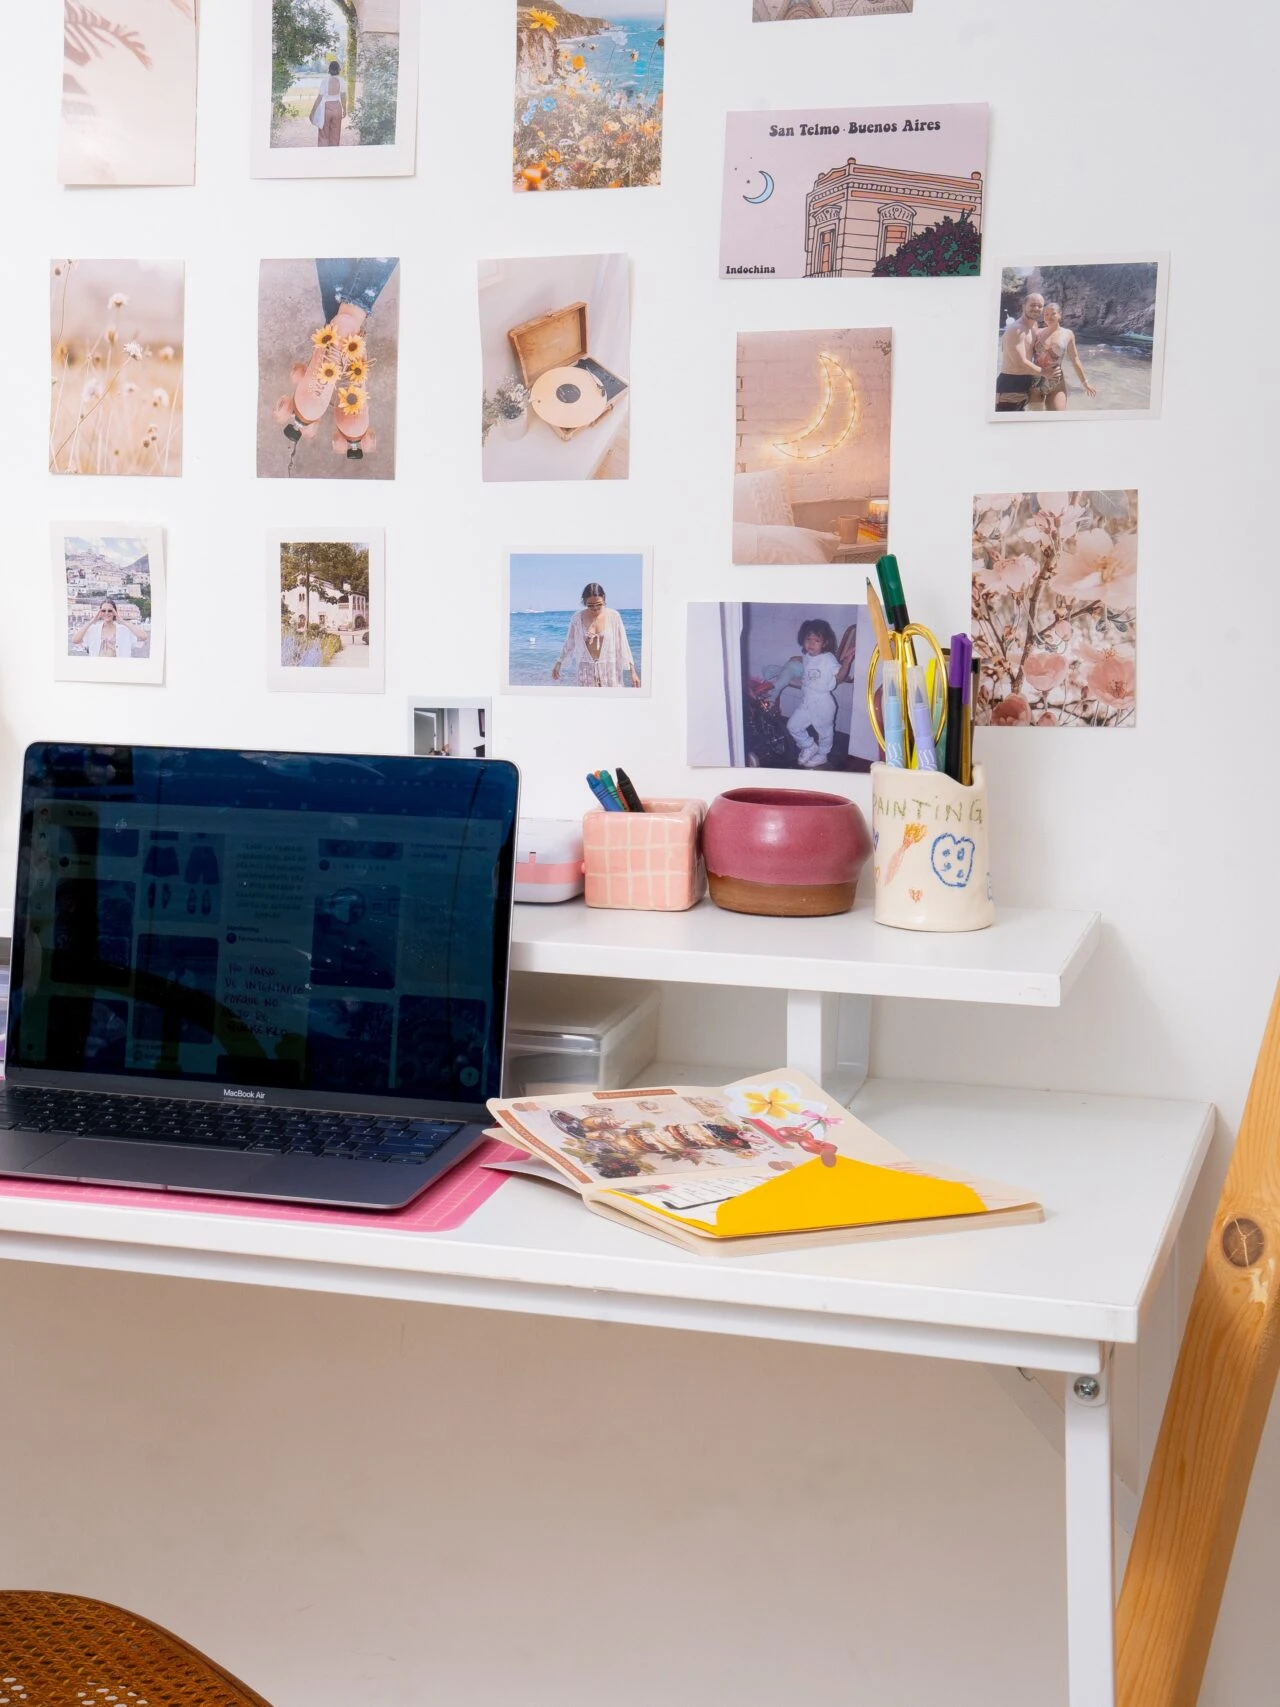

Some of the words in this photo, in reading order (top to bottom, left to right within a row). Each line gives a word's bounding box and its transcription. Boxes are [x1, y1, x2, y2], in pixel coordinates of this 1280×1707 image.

[769, 124, 795, 138] San
[799, 123, 840, 136] Telmo
[848, 121, 898, 135] Buenos
[902, 119, 941, 132] Aires
[725, 265, 776, 275] Indochina
[223, 1088, 255, 1099] MacBook
[255, 1091, 266, 1099] Air
